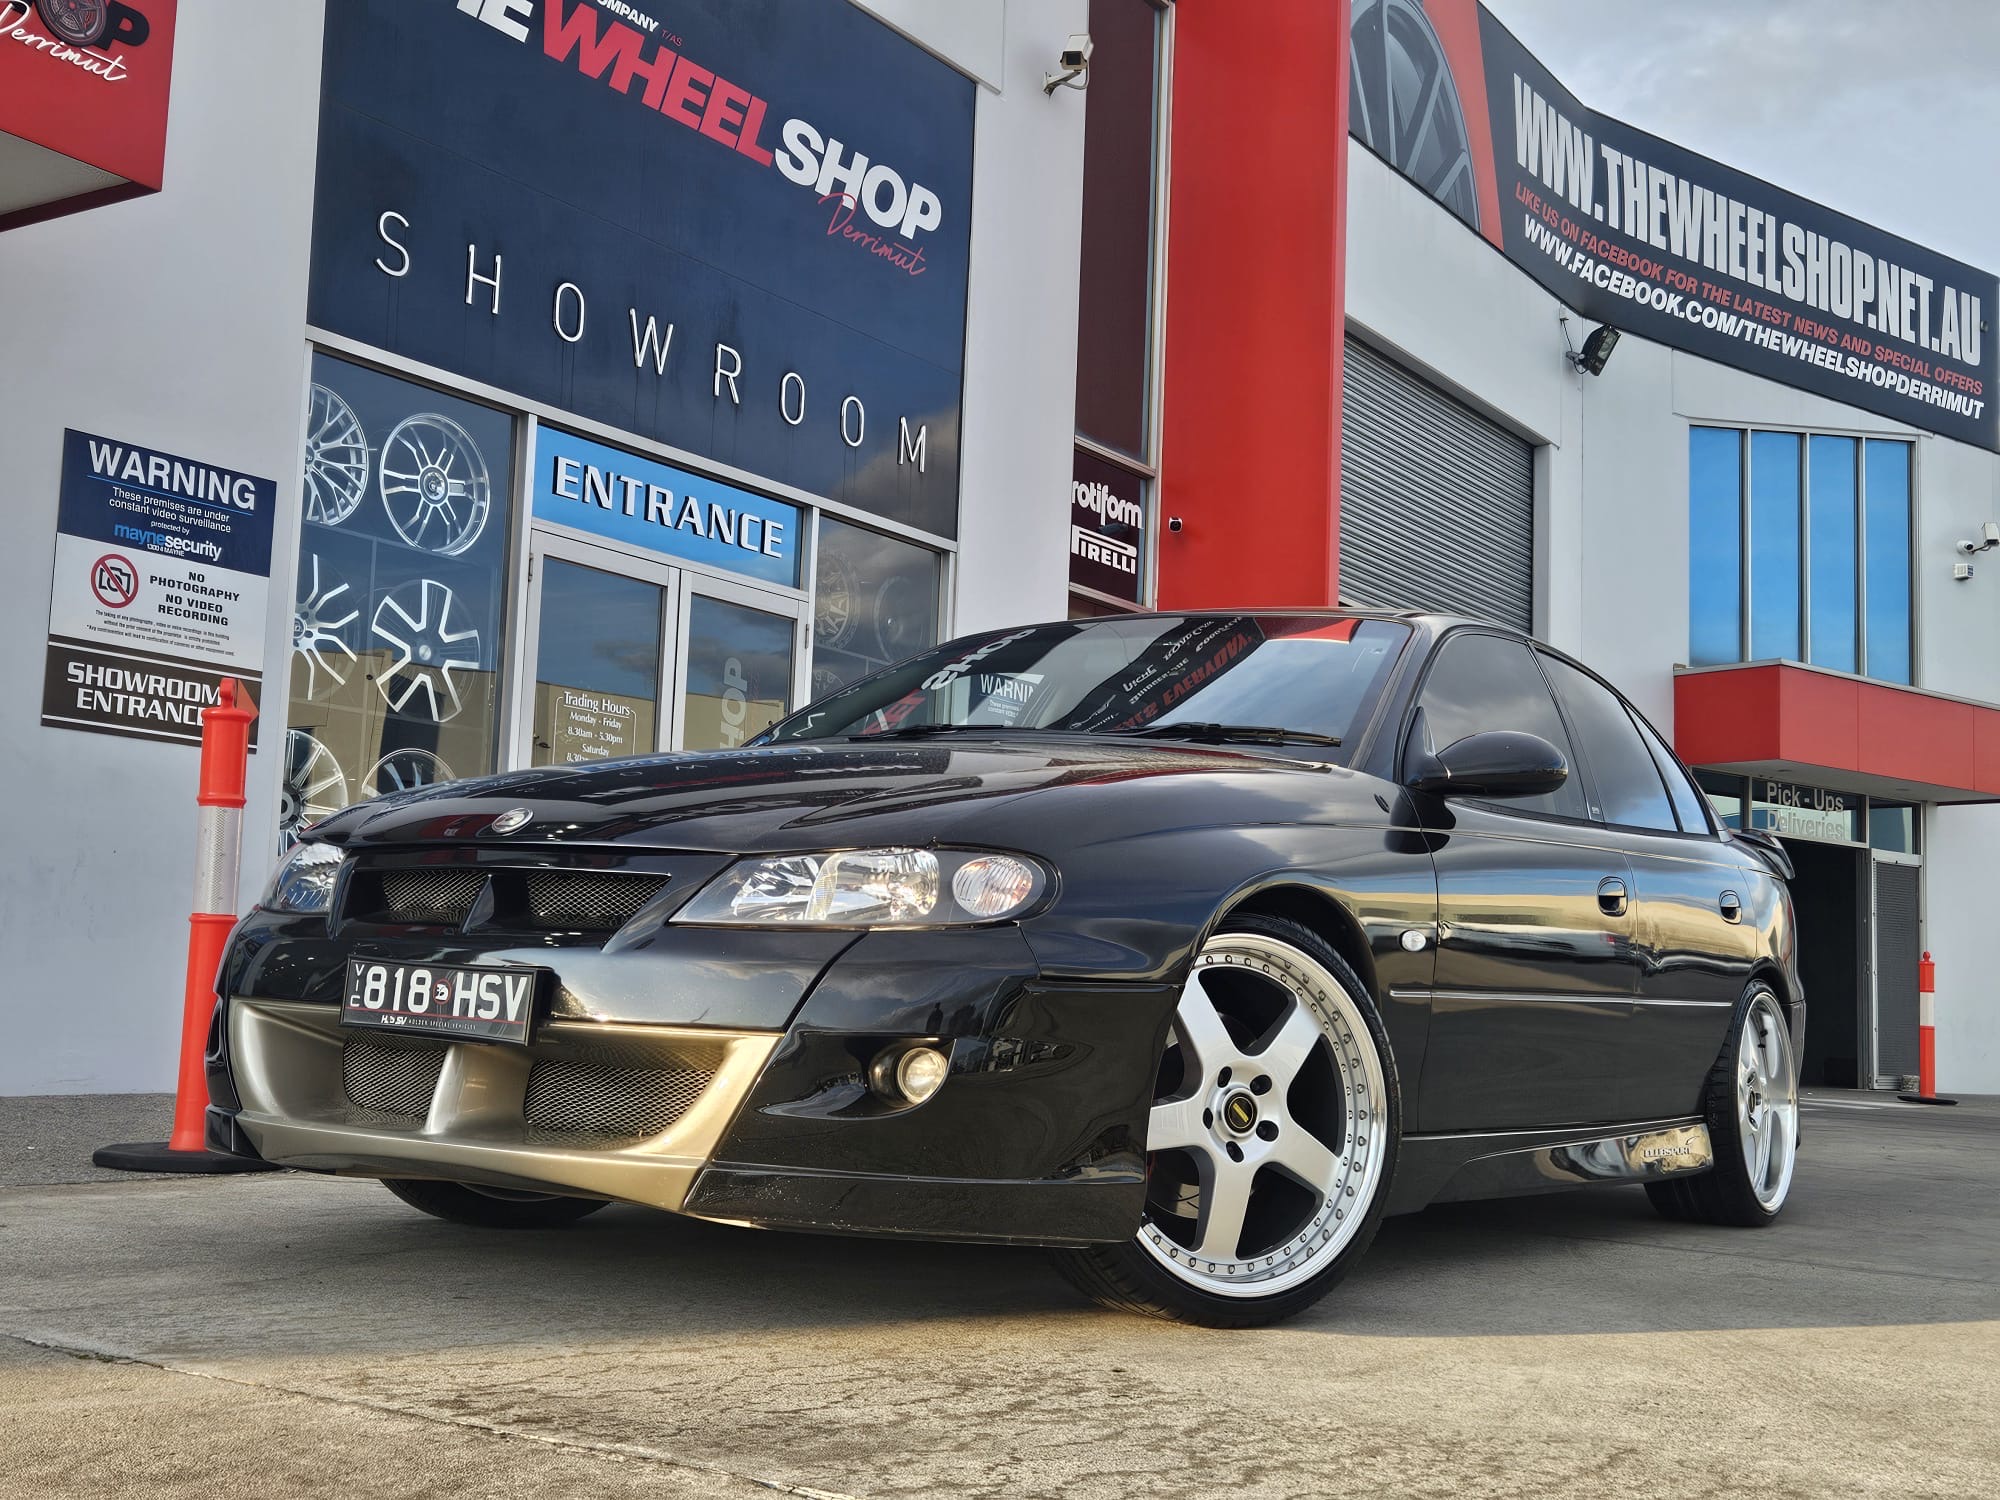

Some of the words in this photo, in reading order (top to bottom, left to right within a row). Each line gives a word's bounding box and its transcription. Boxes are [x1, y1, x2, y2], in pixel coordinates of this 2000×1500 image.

[0, 0, 127, 81] Derrimut
[543, 0, 774, 167] WHEEL
[775, 118, 942, 240] SHOP
[818, 193, 926, 276] Derrimut
[1513, 72, 1981, 367] WWW.THEWHEELSHOP.NET.AU
[1515, 181, 1540, 215] LIKE
[1542, 203, 1559, 228] US
[1561, 217, 1580, 243] ON
[1580, 231, 1664, 282] FACEBOOK
[1665, 268, 1698, 295] FOR
[1702, 281, 1733, 306] THE
[1733, 293, 1792, 328] LATEST
[1793, 315, 1839, 344] NEWS
[1840, 334, 1872, 357] AND
[1874, 345, 1931, 378] SPECIAL
[1934, 367, 1984, 395] OFFERS
[1524, 214, 1984, 419] WWW.FACEBOOK.COM/THEWHEELSHOPDERRIMUT
[88, 440, 256, 510] WARNING
[109, 498, 150, 515] constant
[151, 504, 177, 521] video
[179, 512, 232, 533] surveillance
[112, 486, 142, 502] These
[143, 493, 185, 513] premises
[187, 505, 202, 516] are
[204, 508, 230, 523] under
[553, 455, 784, 559] ENTRANCE
[1071, 481, 1142, 529] rotiform
[150, 521, 181, 532] protected
[181, 526, 190, 536] by
[1071, 525, 1137, 574] PIRELLI
[149, 575, 240, 602] PHOTOGRAPHY
[188, 571, 205, 584] NO
[157, 604, 229, 627] RECORDING
[165, 593, 183, 604] NO
[187, 597, 223, 614] VIDEO
[67, 661, 220, 705] SHOWROOM
[564, 691, 599, 713] Trading
[602, 698, 631, 716] Hours
[569, 711, 597, 727] Monday
[602, 717, 623, 731] Friday
[567, 726, 593, 739] 8.30am
[599, 731, 623, 745] 5.30pm
[582, 743, 610, 757] Saturday
[1767, 782, 1800, 806] Pick
[1813, 788, 1845, 814] Ups
[1767, 809, 1844, 840] Deliveries
[350, 963, 365, 1008] VIC
[363, 965, 432, 1014] 818
[452, 972, 528, 1022] HSV
